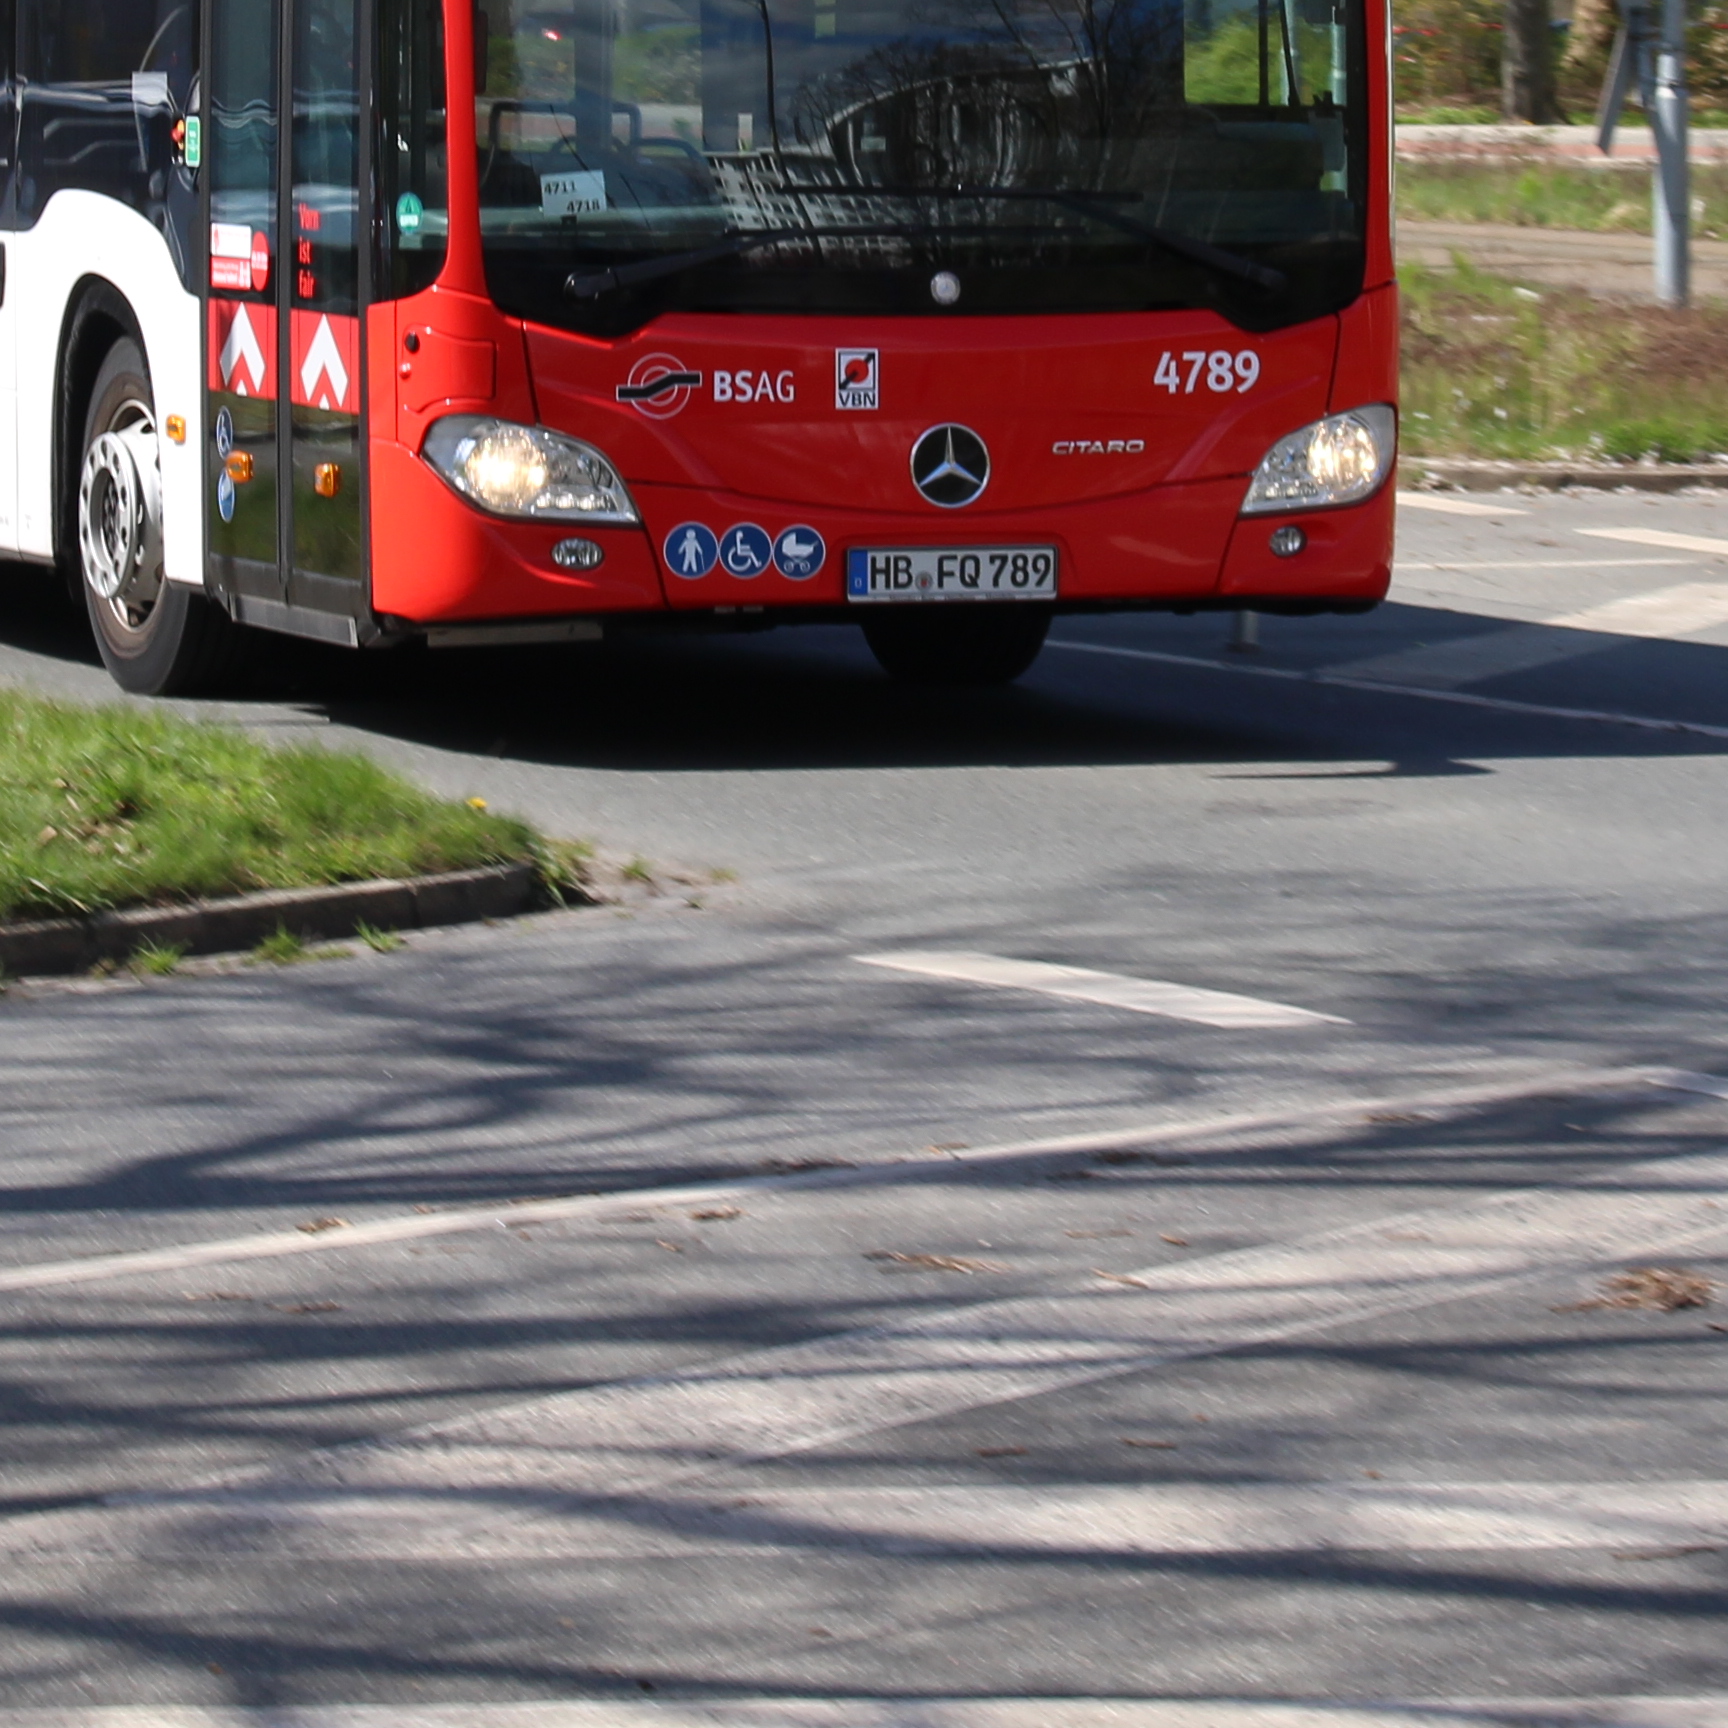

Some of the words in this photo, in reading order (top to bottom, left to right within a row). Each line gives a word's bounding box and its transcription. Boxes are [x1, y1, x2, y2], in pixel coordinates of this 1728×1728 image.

[543, 180, 577, 196] 4711
[566, 198, 601, 214] 4718
[298, 235, 313, 265] ist
[298, 268, 315, 299] fair
[713, 370, 795, 403] BSAG
[1153, 349, 1261, 394] 4789
[838, 392, 876, 407] VBN
[1052, 439, 1145, 454] CITARO
[870, 555, 914, 590] HB
[937, 554, 982, 589] FQ
[988, 554, 1052, 588] 789
